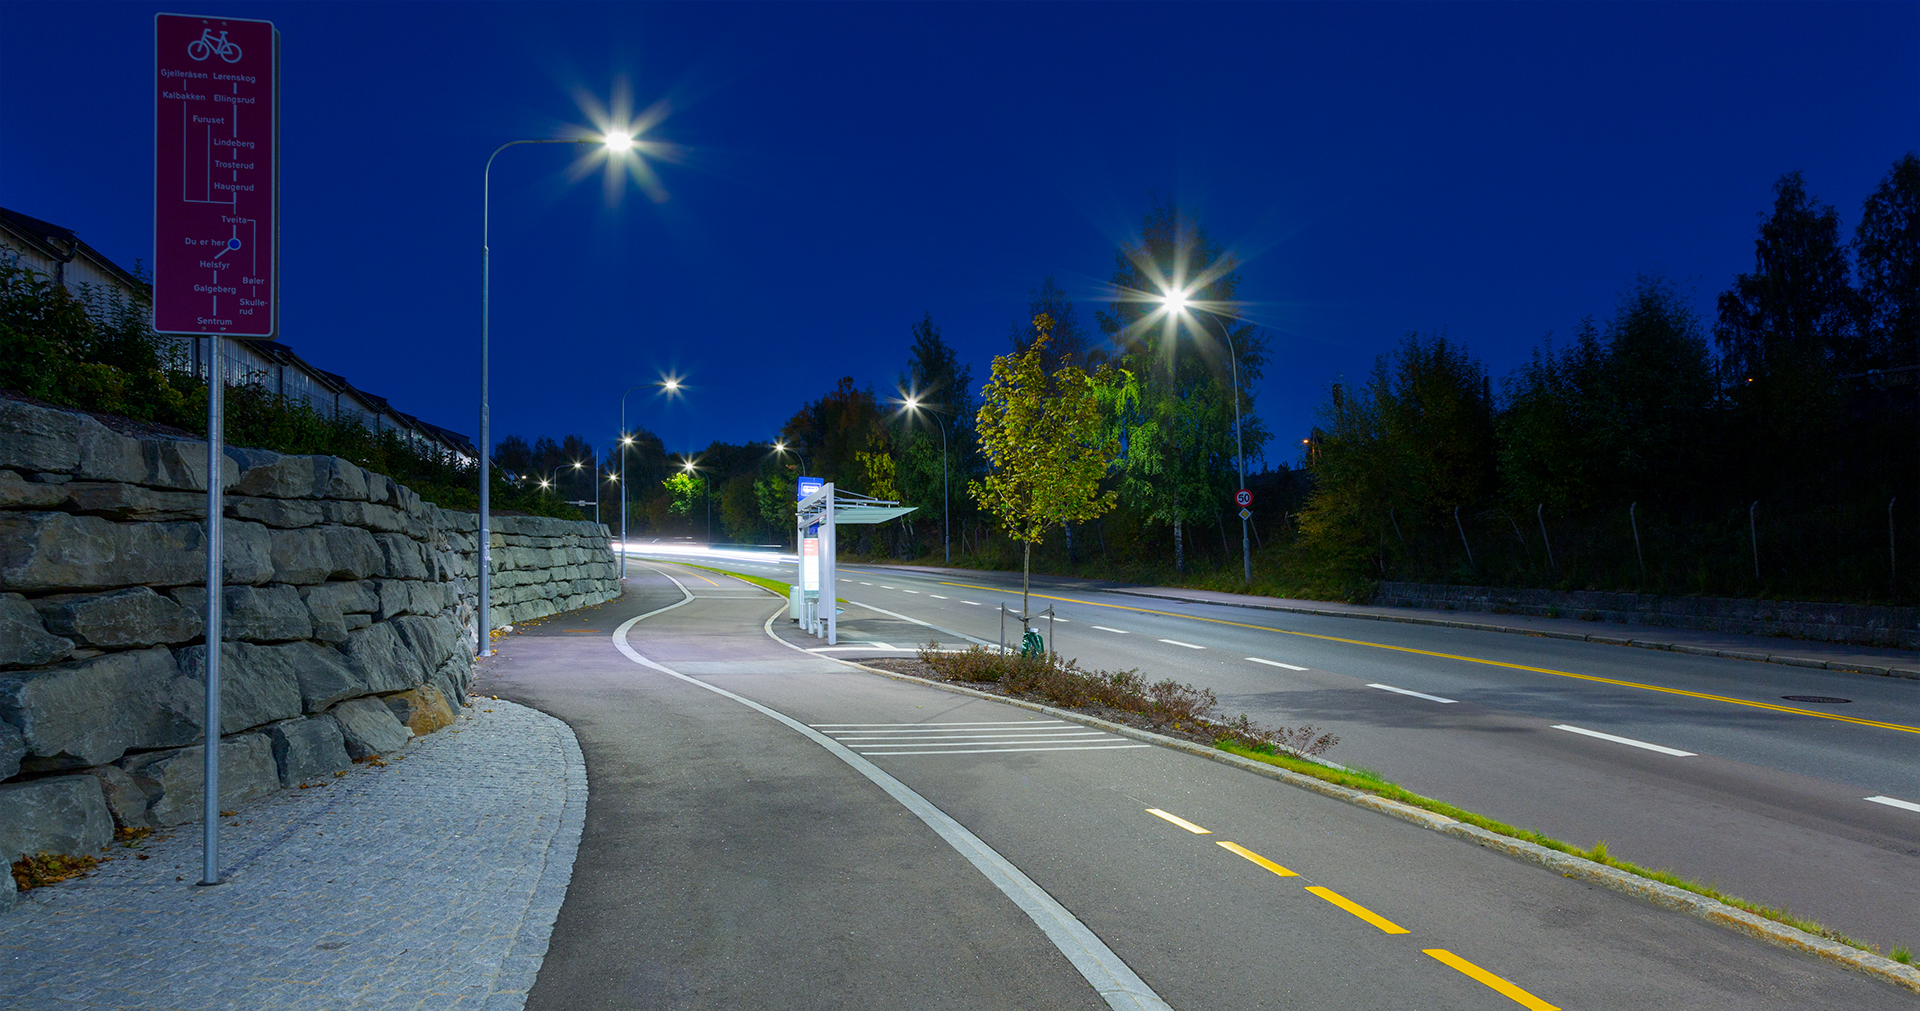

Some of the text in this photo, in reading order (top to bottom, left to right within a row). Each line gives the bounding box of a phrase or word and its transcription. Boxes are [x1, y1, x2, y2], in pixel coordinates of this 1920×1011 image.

[160, 68, 208, 79] Gjelleråsen
[213, 72, 256, 84] Lørenskog
[162, 91, 206, 100] Kalbakken
[214, 94, 255, 104] Ellingsrud
[193, 115, 225, 124] Furuset
[214, 138, 255, 149] Lindeberg
[215, 160, 254, 170] Trosterud
[214, 182, 254, 192] Haugerud
[221, 215, 247, 224] Tveita
[200, 261, 230, 270] Helsfyr
[194, 285, 237, 295] Galgeberg
[240, 298, 268, 306] Skulle-
[197, 317, 232, 325] Sentrum
[1238, 494, 1250, 502] 50
